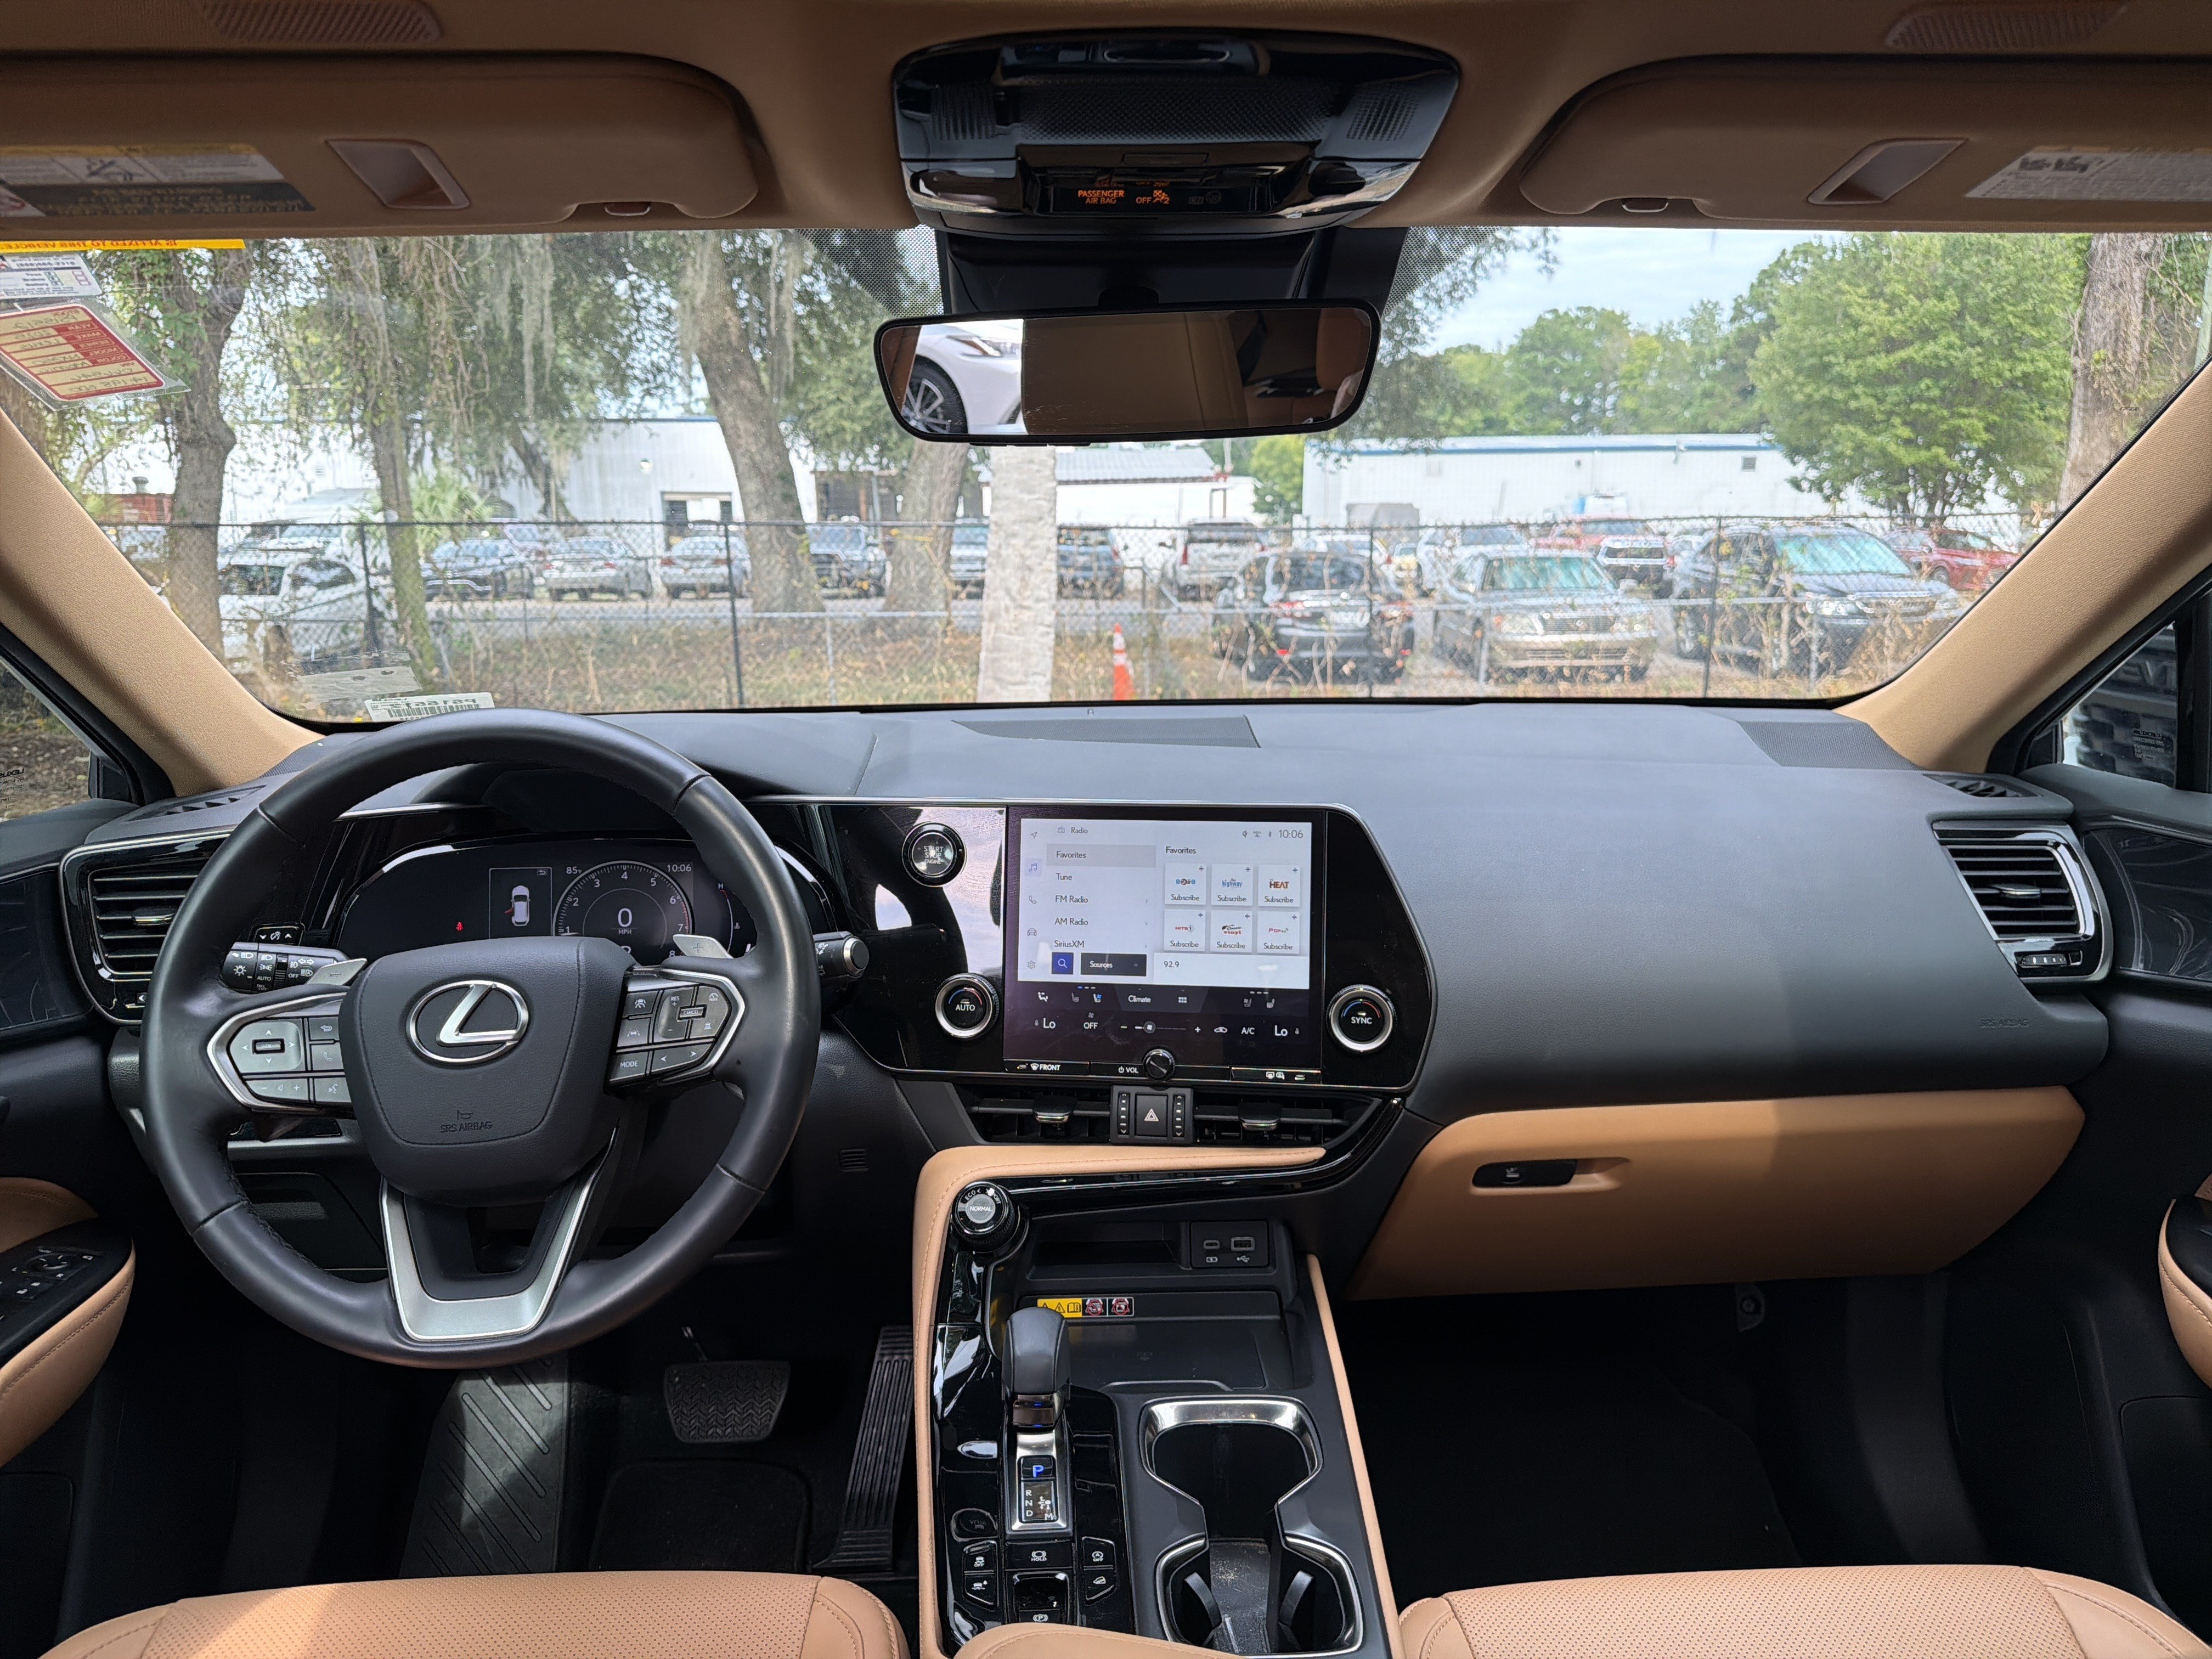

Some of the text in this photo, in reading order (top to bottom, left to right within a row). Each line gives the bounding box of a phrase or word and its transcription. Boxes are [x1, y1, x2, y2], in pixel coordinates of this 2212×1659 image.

[1279, 830, 1304, 839] 10:06
[667, 864, 692, 872] 10:06
[620, 871, 628, 879] 4
[594, 879, 600, 888] 3
[650, 878, 657, 887] 5
[1222, 879, 1242, 888] highway
[1269, 881, 1289, 889] HEAT
[573, 898, 579, 906] 2
[669, 896, 676, 905] 6
[617, 908, 633, 927] 0
[566, 926, 570, 934] 1
[678, 923, 684, 932] 7
[1054, 940, 1085, 948] SiriusXM
[1090, 960, 1113, 968] Sources
[1128, 995, 1151, 1003] Climate
[1043, 1018, 1056, 1029] Lo
[1351, 1017, 1372, 1025] SYNC
[1980, 1019, 2029, 1028] SRS AIRBAG
[1084, 1022, 1098, 1030] OFF
[1241, 1026, 1255, 1035] A/C
[1274, 1025, 1288, 1036] Lo
[620, 1060, 638, 1068] MODE
[441, 1121, 493, 1133] SRS AIRBAG
[964, 1189, 976, 1201] ECO
[1032, 1465, 1044, 1477] P
